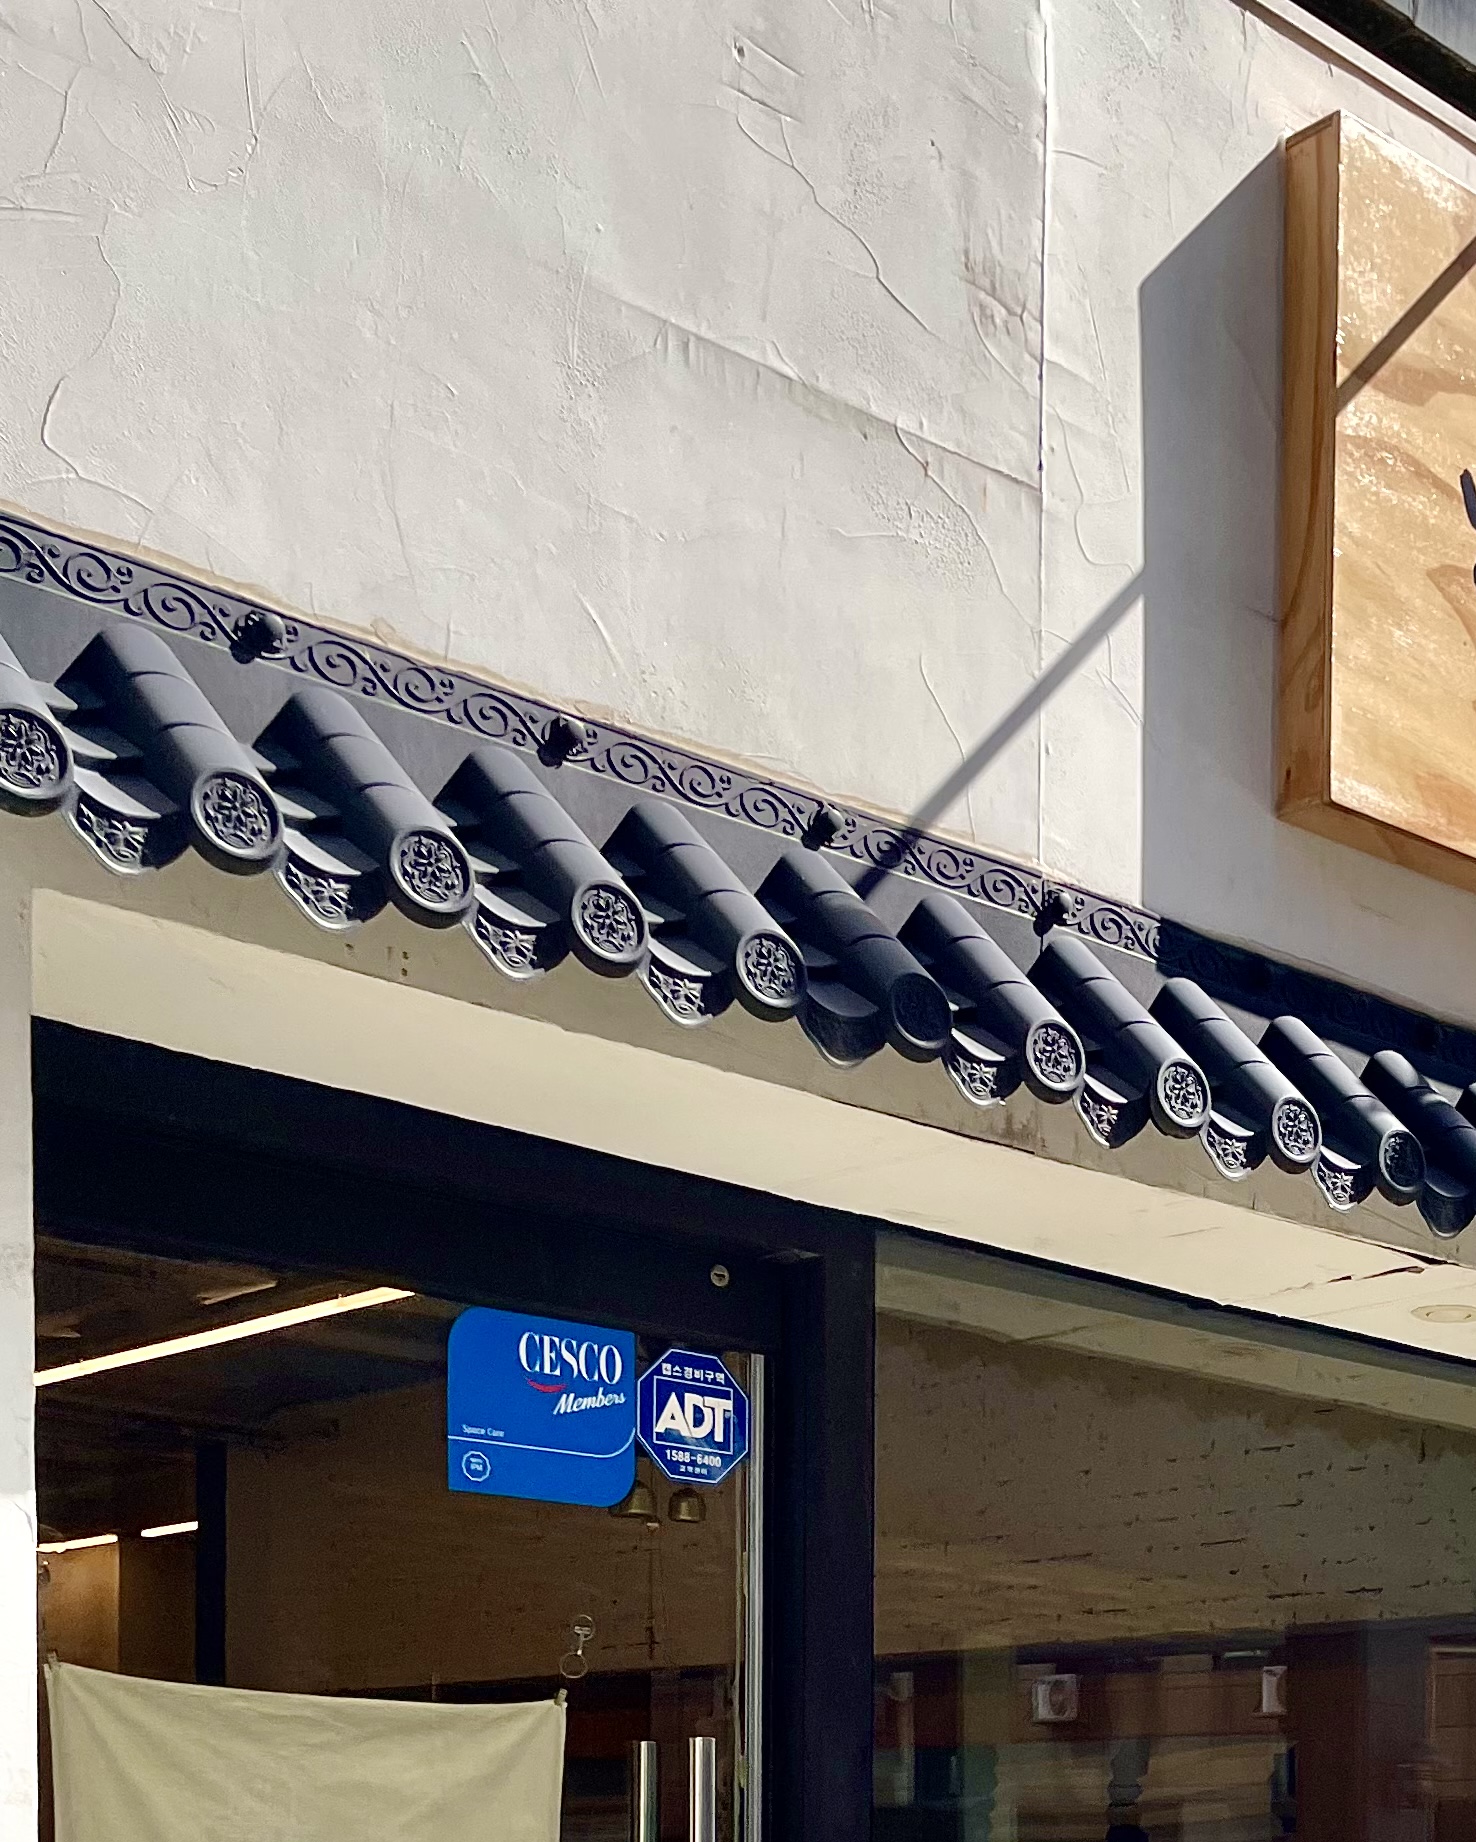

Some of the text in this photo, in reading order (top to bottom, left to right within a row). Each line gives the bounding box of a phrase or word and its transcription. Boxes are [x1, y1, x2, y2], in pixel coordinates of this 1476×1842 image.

[518, 1330, 623, 1385] CESCO
[552, 1386, 627, 1416] Members
[654, 1391, 733, 1443] ADT
[665, 1448, 723, 1468] 1588-6400
